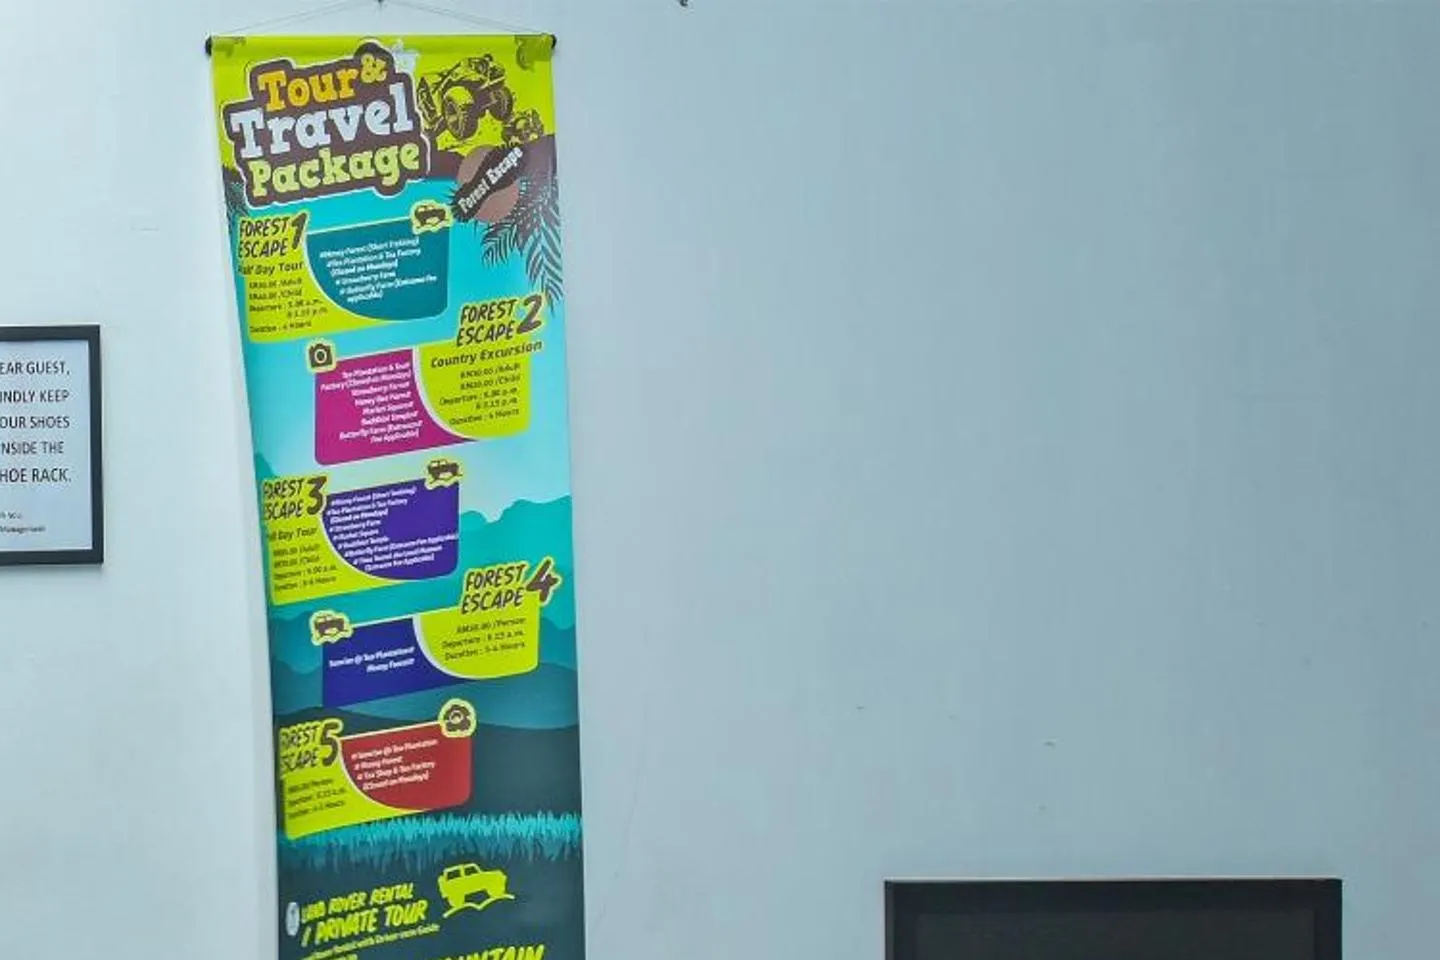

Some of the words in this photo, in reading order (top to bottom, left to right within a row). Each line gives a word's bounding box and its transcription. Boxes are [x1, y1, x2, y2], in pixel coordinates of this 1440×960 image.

[229, 82, 413, 159] Travel
[247, 143, 421, 199] Package
[486, 147, 523, 184] Escape
[240, 216, 290, 237] FOREST
[291, 212, 308, 250] 1
[239, 238, 289, 258] ESCAPE
[279, 261, 304, 272] Tour
[461, 299, 517, 325] FOREST
[516, 294, 542, 334] 2
[456, 320, 515, 347] ESCAPE
[430, 352, 477, 368] Country
[479, 341, 543, 361] Excursion
[26, 361, 70, 376] GUEST,
[39, 390, 69, 402] KEEP
[30, 415, 70, 429] SHOES
[42, 441, 64, 454] THE
[32, 467, 72, 483] RACK.
[306, 476, 327, 516] 3
[466, 564, 527, 591] FOREST
[525, 558, 559, 602] 4
[461, 587, 525, 615] ESCAPE
[320, 720, 339, 767] 5
[369, 882, 414, 906] RENTAL
[314, 908, 379, 945] PRIVATE
[383, 899, 428, 927] TOUR
